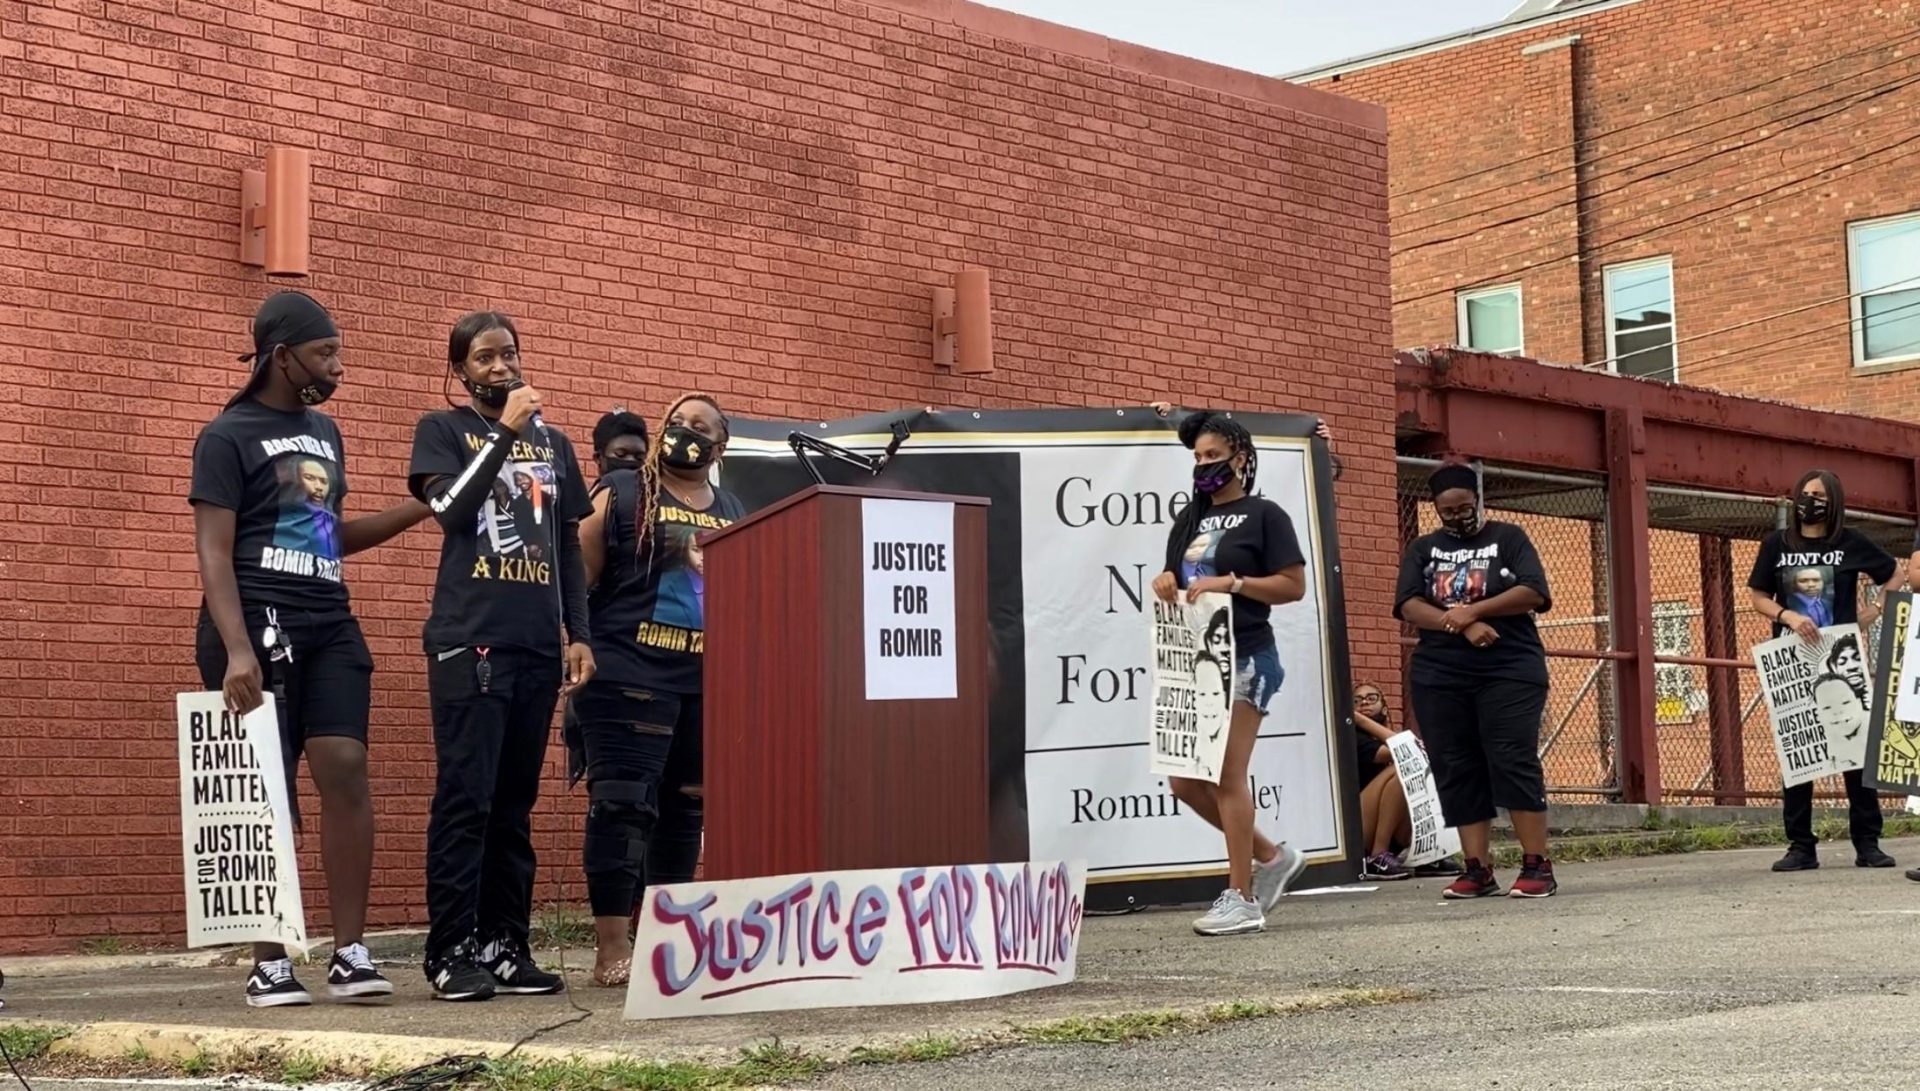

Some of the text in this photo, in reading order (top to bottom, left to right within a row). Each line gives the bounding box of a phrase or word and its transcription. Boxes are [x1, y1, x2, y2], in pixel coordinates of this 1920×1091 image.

[1056, 476, 1190, 528] Gone
[659, 506, 722, 530] JUSTICE
[1224, 514, 1249, 530] OF
[260, 546, 315, 576] ROMIR
[872, 541, 946, 572] JUSTICE
[1431, 543, 1498, 563] JUSTICE FOR
[1776, 550, 1845, 567] AUNT OF
[472, 555, 550, 585] A KING
[893, 585, 928, 614] FOR
[1154, 601, 1187, 626] BLACK
[636, 621, 689, 652] ROMIR
[880, 628, 942, 657] ROMIR
[1156, 625, 1194, 650] FAMILIES
[1157, 648, 1195, 674] MATTER
[1761, 645, 1800, 673] BLACK
[1766, 661, 1812, 689] FAMILIES
[1156, 686, 1197, 711] JUSTICE
[1771, 680, 1814, 708] MATTER
[190, 709, 247, 742] BLAC
[1165, 710, 1198, 733] ROMIR
[1778, 708, 1820, 735] JUSTICE
[1156, 731, 1197, 759] TALLEY
[1782, 725, 1827, 752] FOR ROMIR
[191, 743, 261, 771] FAMILI
[1786, 742, 1829, 771] TALLEY
[194, 824, 274, 855] JUSTICE
[1413, 832, 1438, 856] TALLEY
[197, 854, 278, 885] FOR ROMIR
[200, 884, 277, 918] TALLEY
[898, 865, 983, 966] FOR
